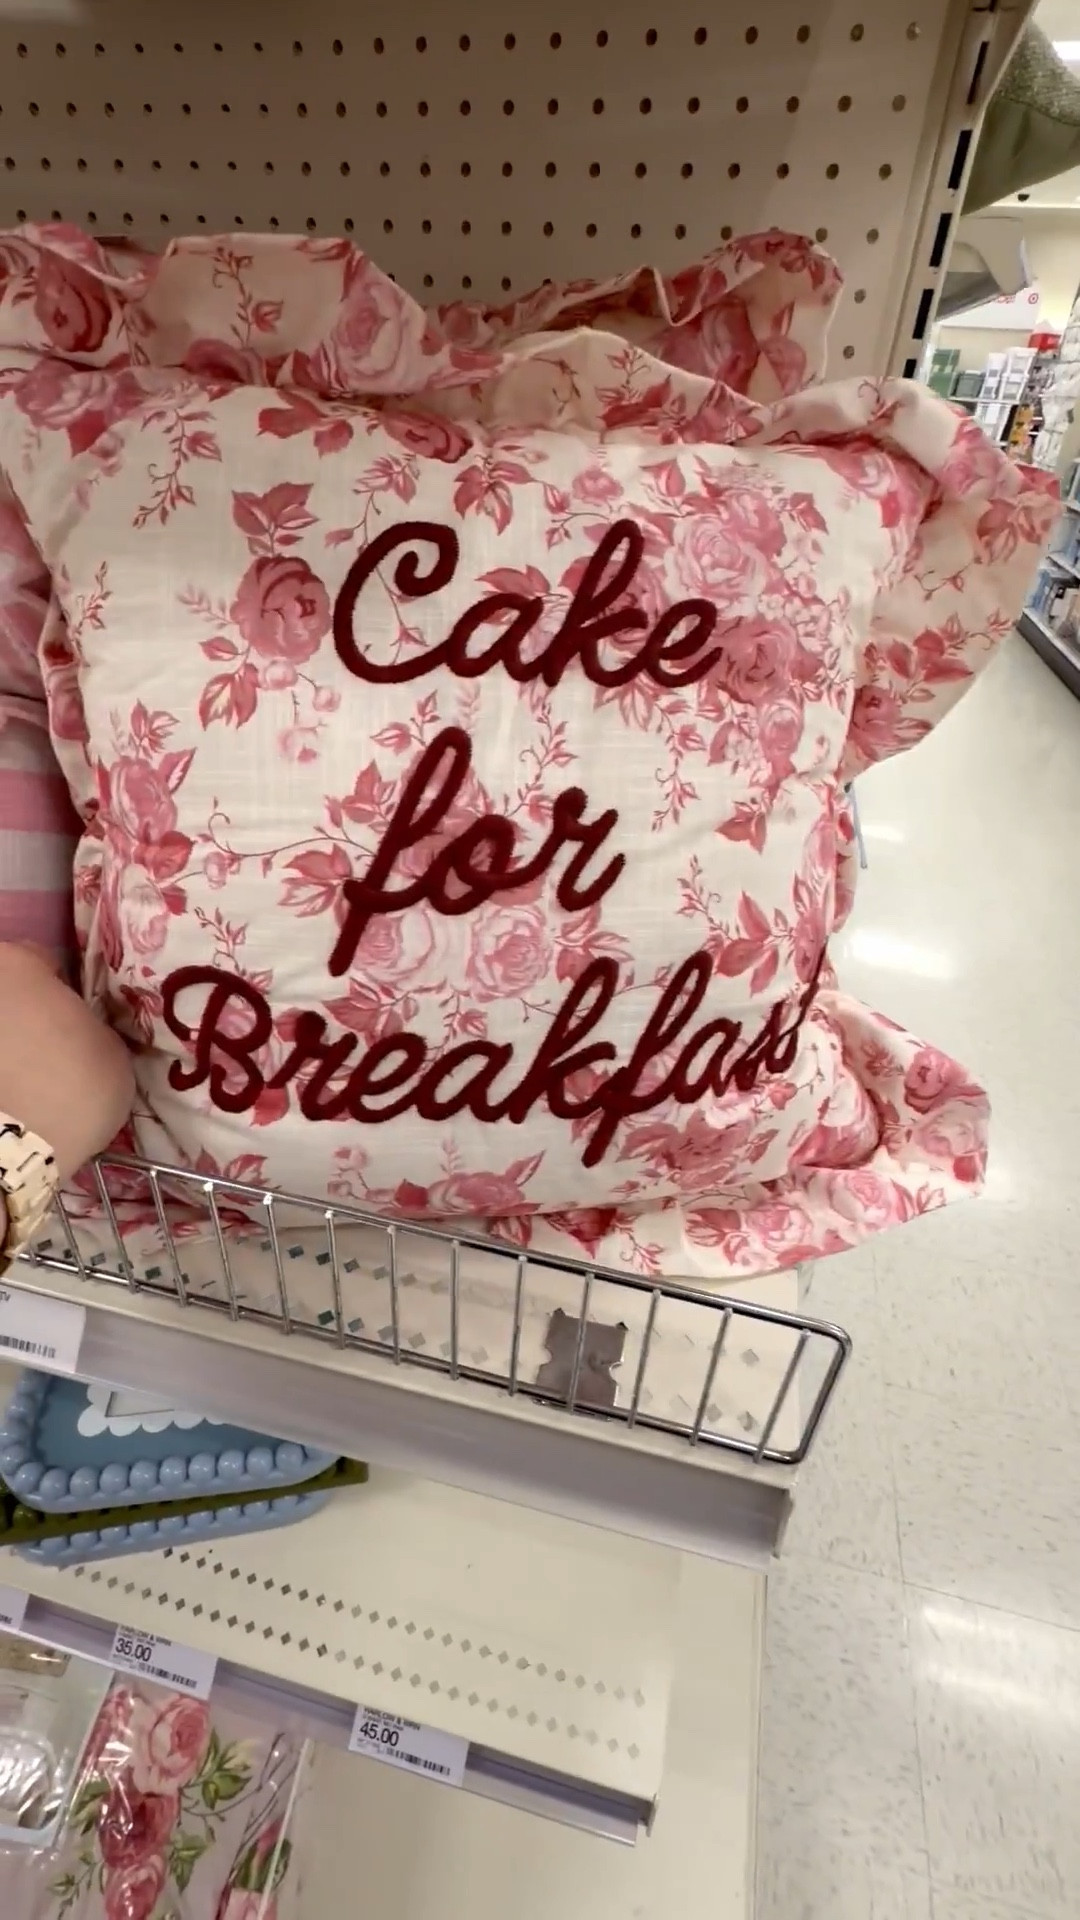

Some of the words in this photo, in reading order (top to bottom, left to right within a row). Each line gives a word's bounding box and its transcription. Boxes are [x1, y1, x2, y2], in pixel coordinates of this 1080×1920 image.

[333, 519, 723, 688] Cake
[327, 726, 626, 978] for
[115, 1637, 152, 1662] 35.00
[360, 1721, 399, 1747] 45.00
